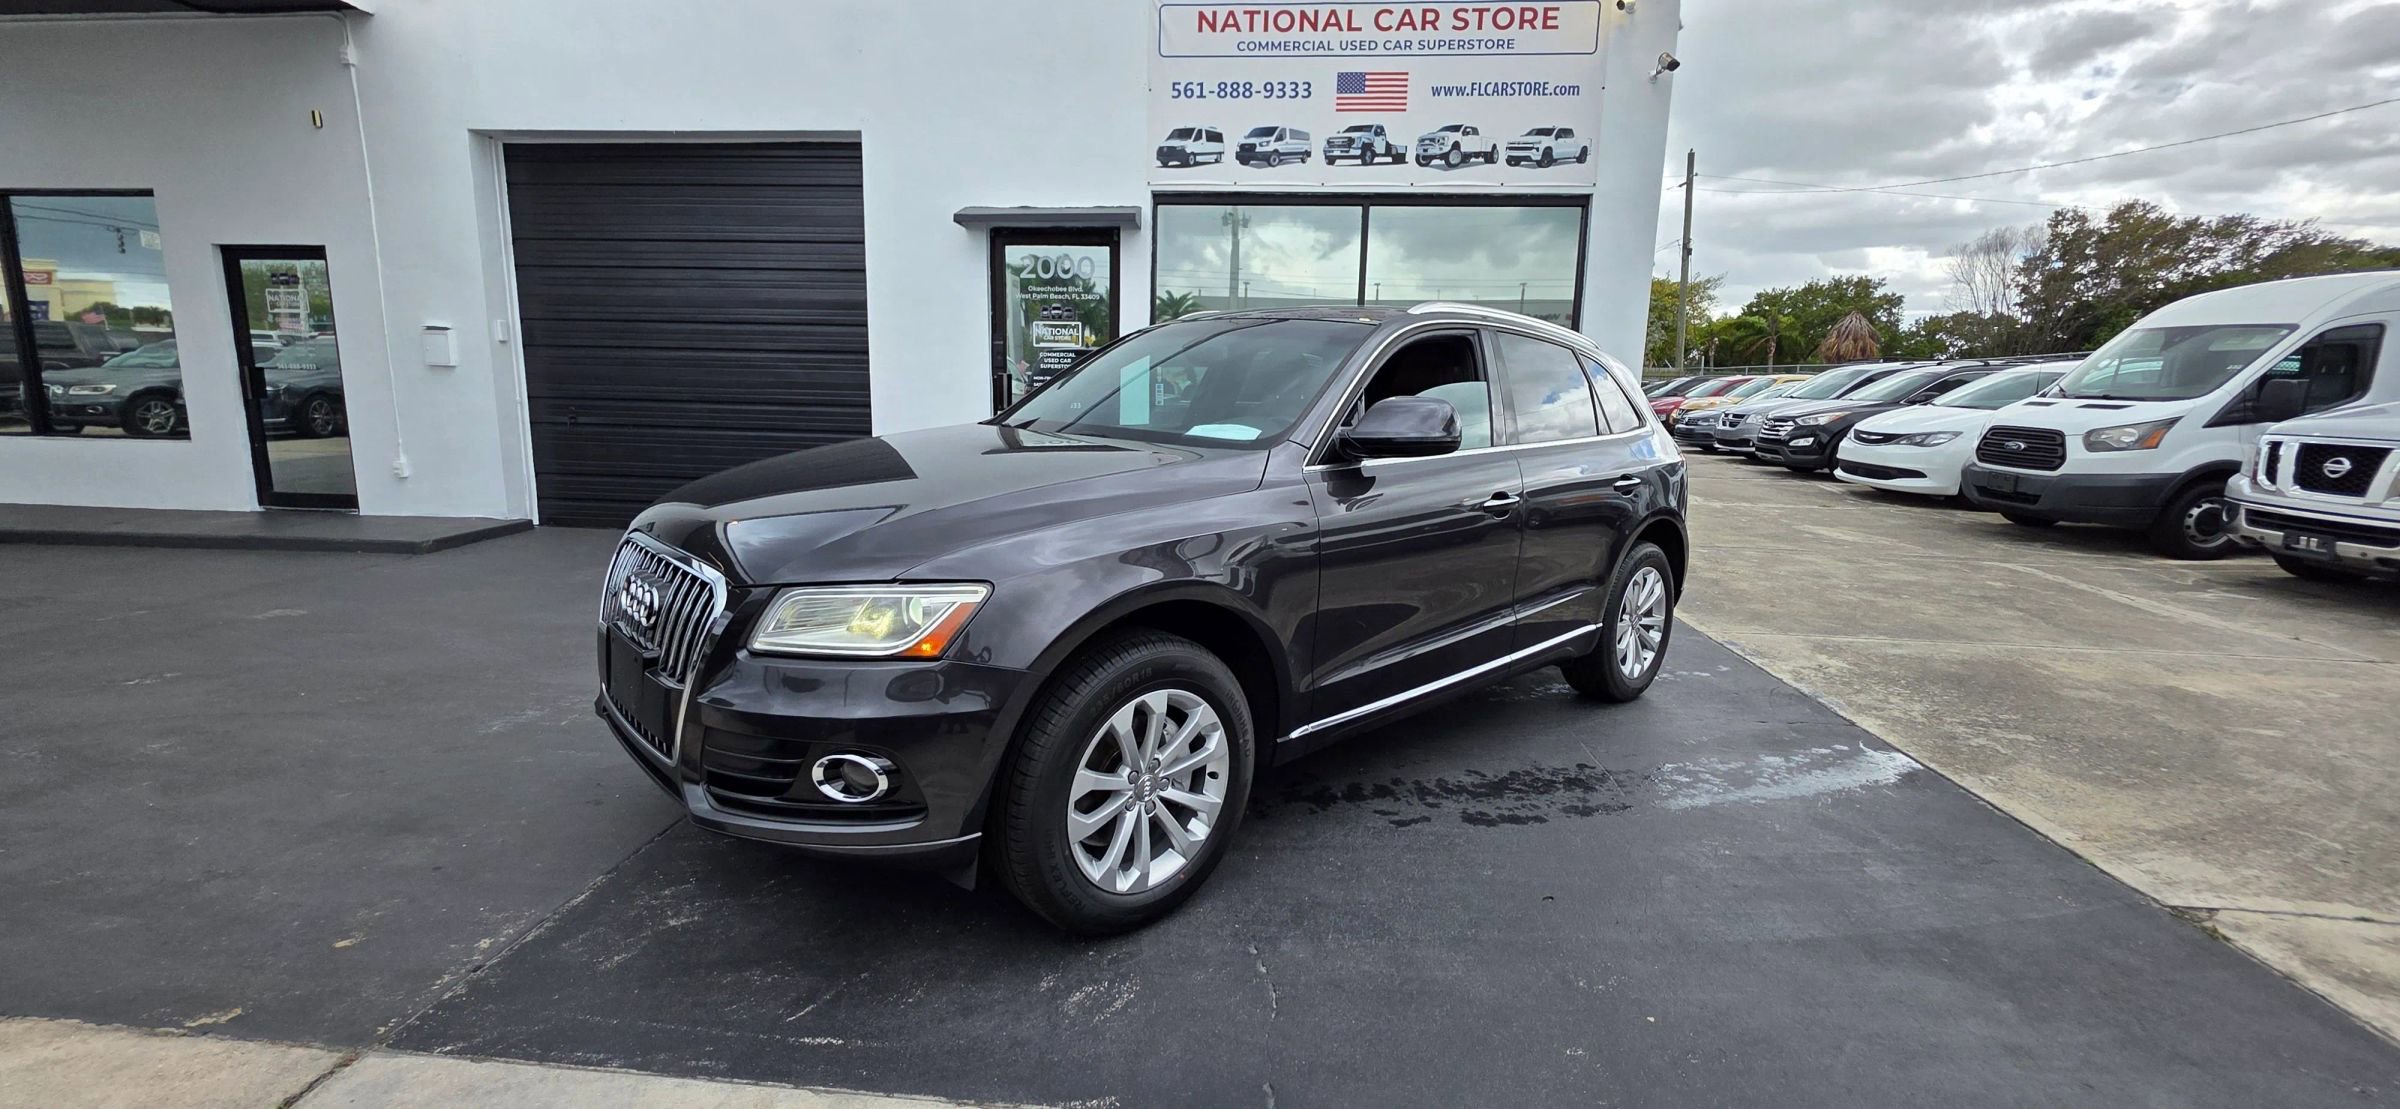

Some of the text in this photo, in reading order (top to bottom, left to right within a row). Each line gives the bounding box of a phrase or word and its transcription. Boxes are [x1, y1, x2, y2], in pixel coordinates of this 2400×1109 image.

[1197, 6, 1561, 33] NATIONAL CAR STORE
[1236, 38, 1515, 52] COMMERCIAL USED CAR SUPERSTORE
[1171, 81, 1312, 99] 561-888-9333
[1431, 81, 1580, 97] www.FLCARSTORE.com
[1020, 255, 1095, 279] 2000
[1035, 327, 1079, 336] NATIONAL
